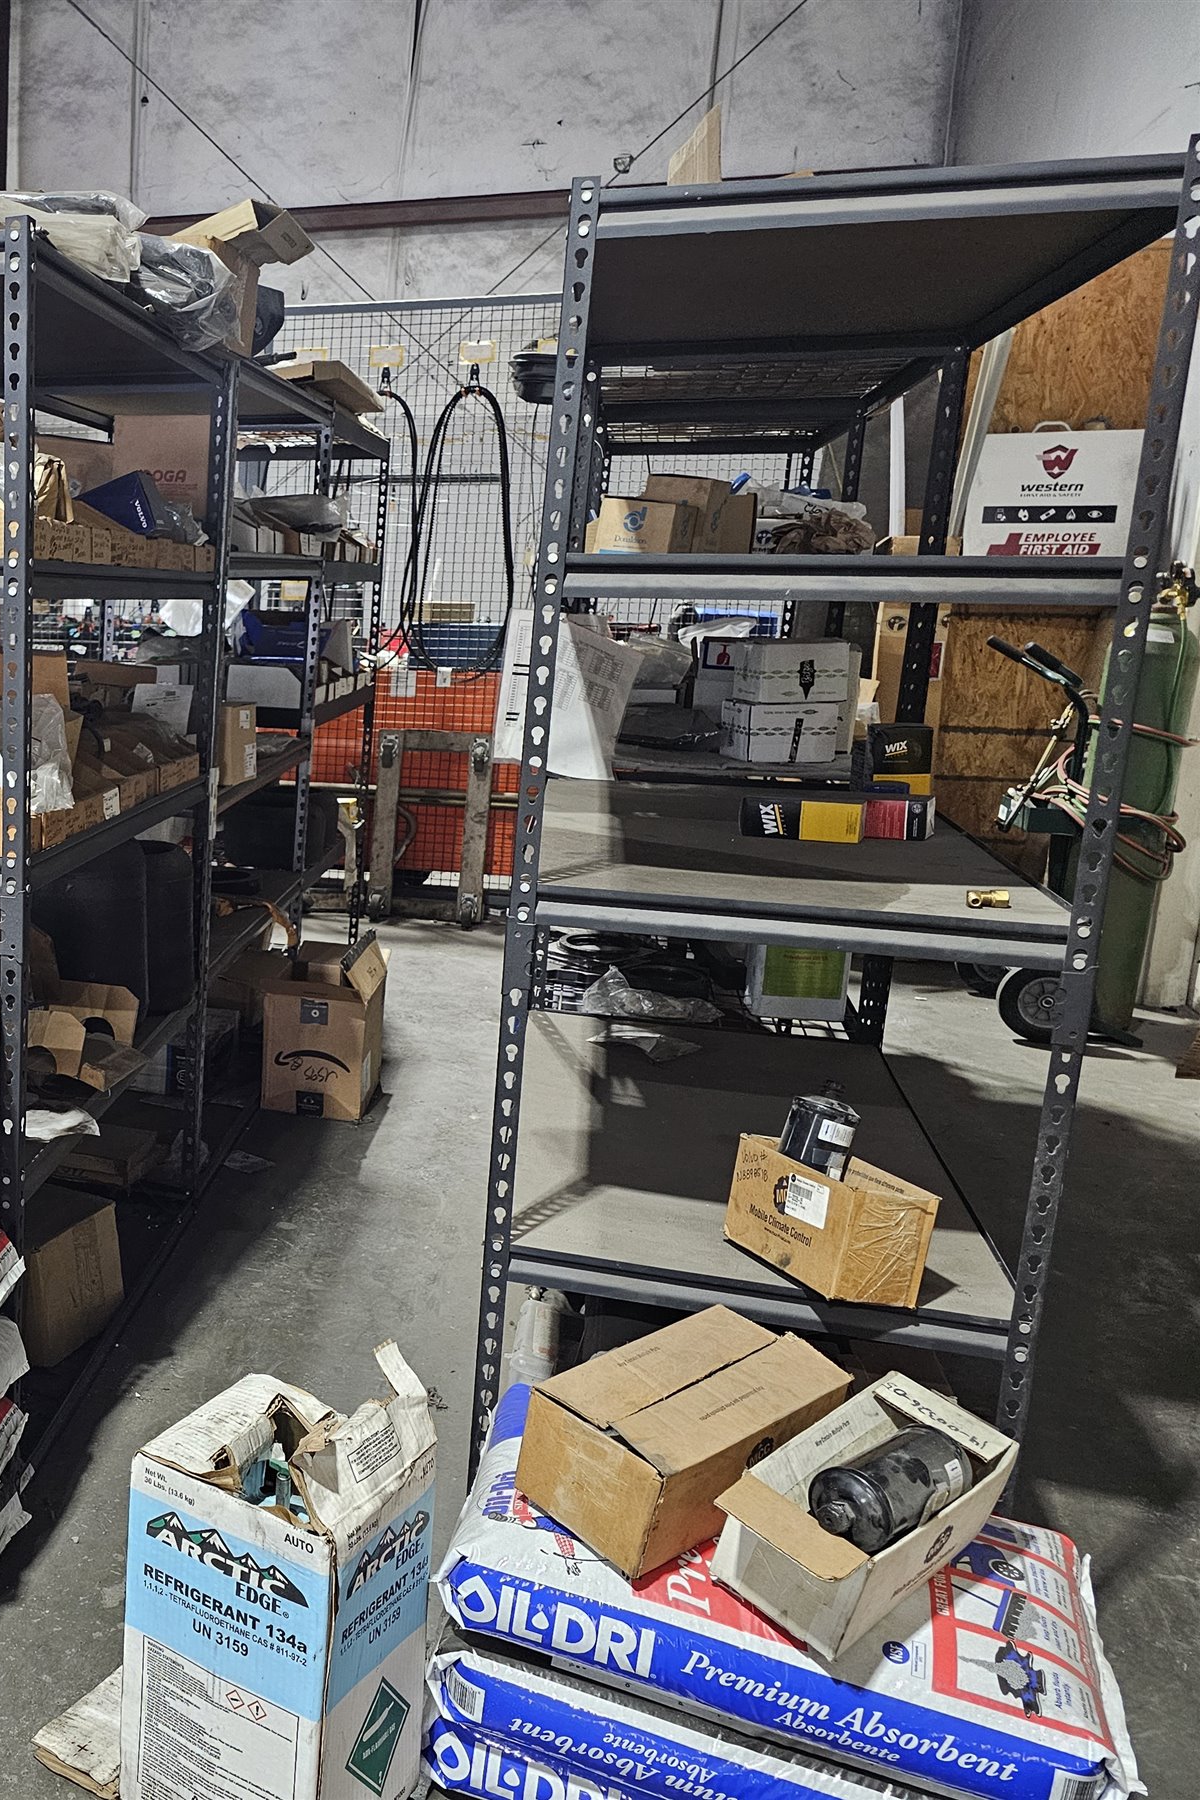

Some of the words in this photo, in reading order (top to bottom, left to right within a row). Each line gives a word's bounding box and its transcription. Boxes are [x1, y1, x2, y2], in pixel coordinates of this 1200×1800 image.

[1020, 482, 1084, 492] western
[134, 499, 148, 529] VOLVO
[1019, 544, 1059, 555] FIRST
[1062, 544, 1090, 555] AID
[1024, 532, 1097, 542] EMPLOYEE
[885, 740, 908, 754] WIX
[759, 803, 779, 835] WIX
[750, 1203, 769, 1223] Mobile
[767, 1211, 790, 1235] Climate
[789, 1223, 812, 1248] Control
[145, 1467, 156, 1478] Net
[153, 1480, 167, 1492] Lbs.
[168, 1486, 182, 1501] (13.6
[182, 1493, 196, 1507] kg)
[284, 1532, 314, 1554] AUTO
[351, 1520, 426, 1596] ARCTIC
[394, 1537, 422, 1571] EDGE
[155, 1528, 286, 1596] ARCTIC
[143, 1563, 261, 1630] REFRIGERANT
[265, 1624, 308, 1654] 134a
[235, 1582, 282, 1616] EDGE
[340, 1574, 409, 1645] REFRIGERANT
[936, 1591, 950, 1617] GREAT
[168, 1591, 250, 1640] TETRAFLUOROETHANE
[251, 1633, 269, 1649] CAS
[276, 1645, 308, 1667] 811-97-2
[192, 1618, 212, 1640] UN
[215, 1631, 249, 1657] 3159
[368, 1625, 381, 1646] UN
[382, 1606, 402, 1634] 3159
[888, 1643, 905, 1662] NSF
[680, 1650, 830, 1722] Premium
[834, 1706, 1018, 1783] Absorbent
[509, 1717, 662, 1782] Absorbent
[773, 1710, 901, 1763] Absorbente
[602, 1731, 718, 1785] Absorbente
